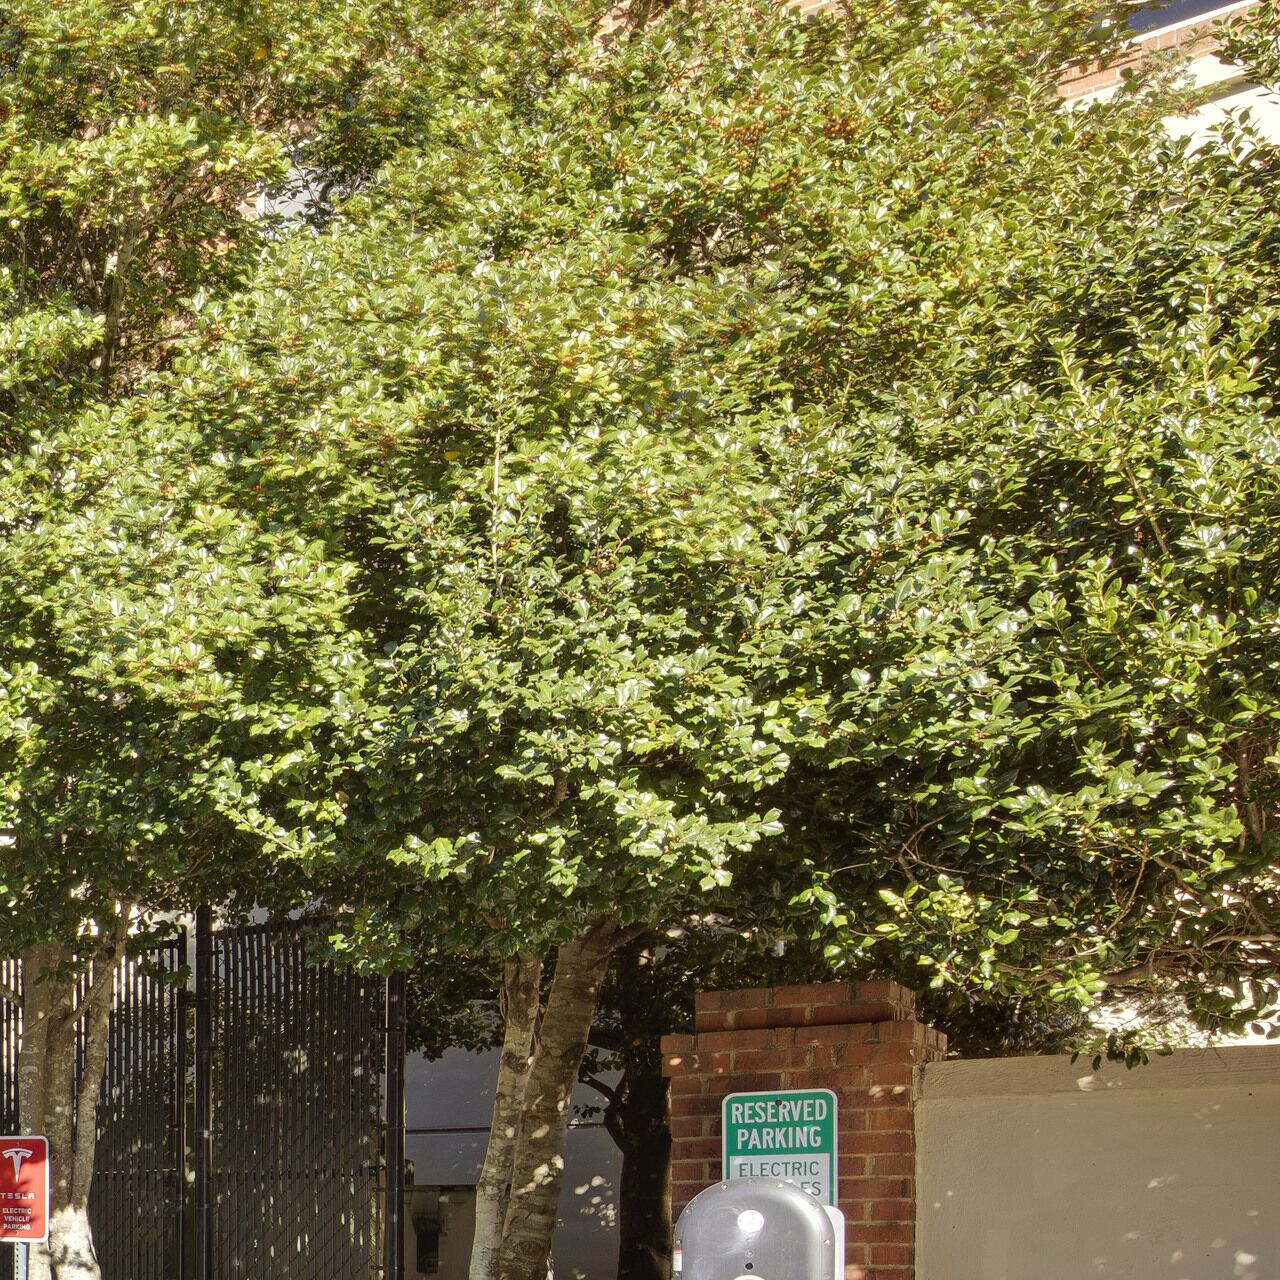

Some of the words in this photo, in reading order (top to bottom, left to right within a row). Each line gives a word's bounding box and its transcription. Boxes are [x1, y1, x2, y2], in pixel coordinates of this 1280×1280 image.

[731, 1099, 828, 1124] RESERVED
[737, 1126, 822, 1150] PARKING
[739, 1161, 820, 1177] ELECTRIC
[0, 1192, 35, 1200] TESLA
[3, 1223, 31, 1231] PARKING
